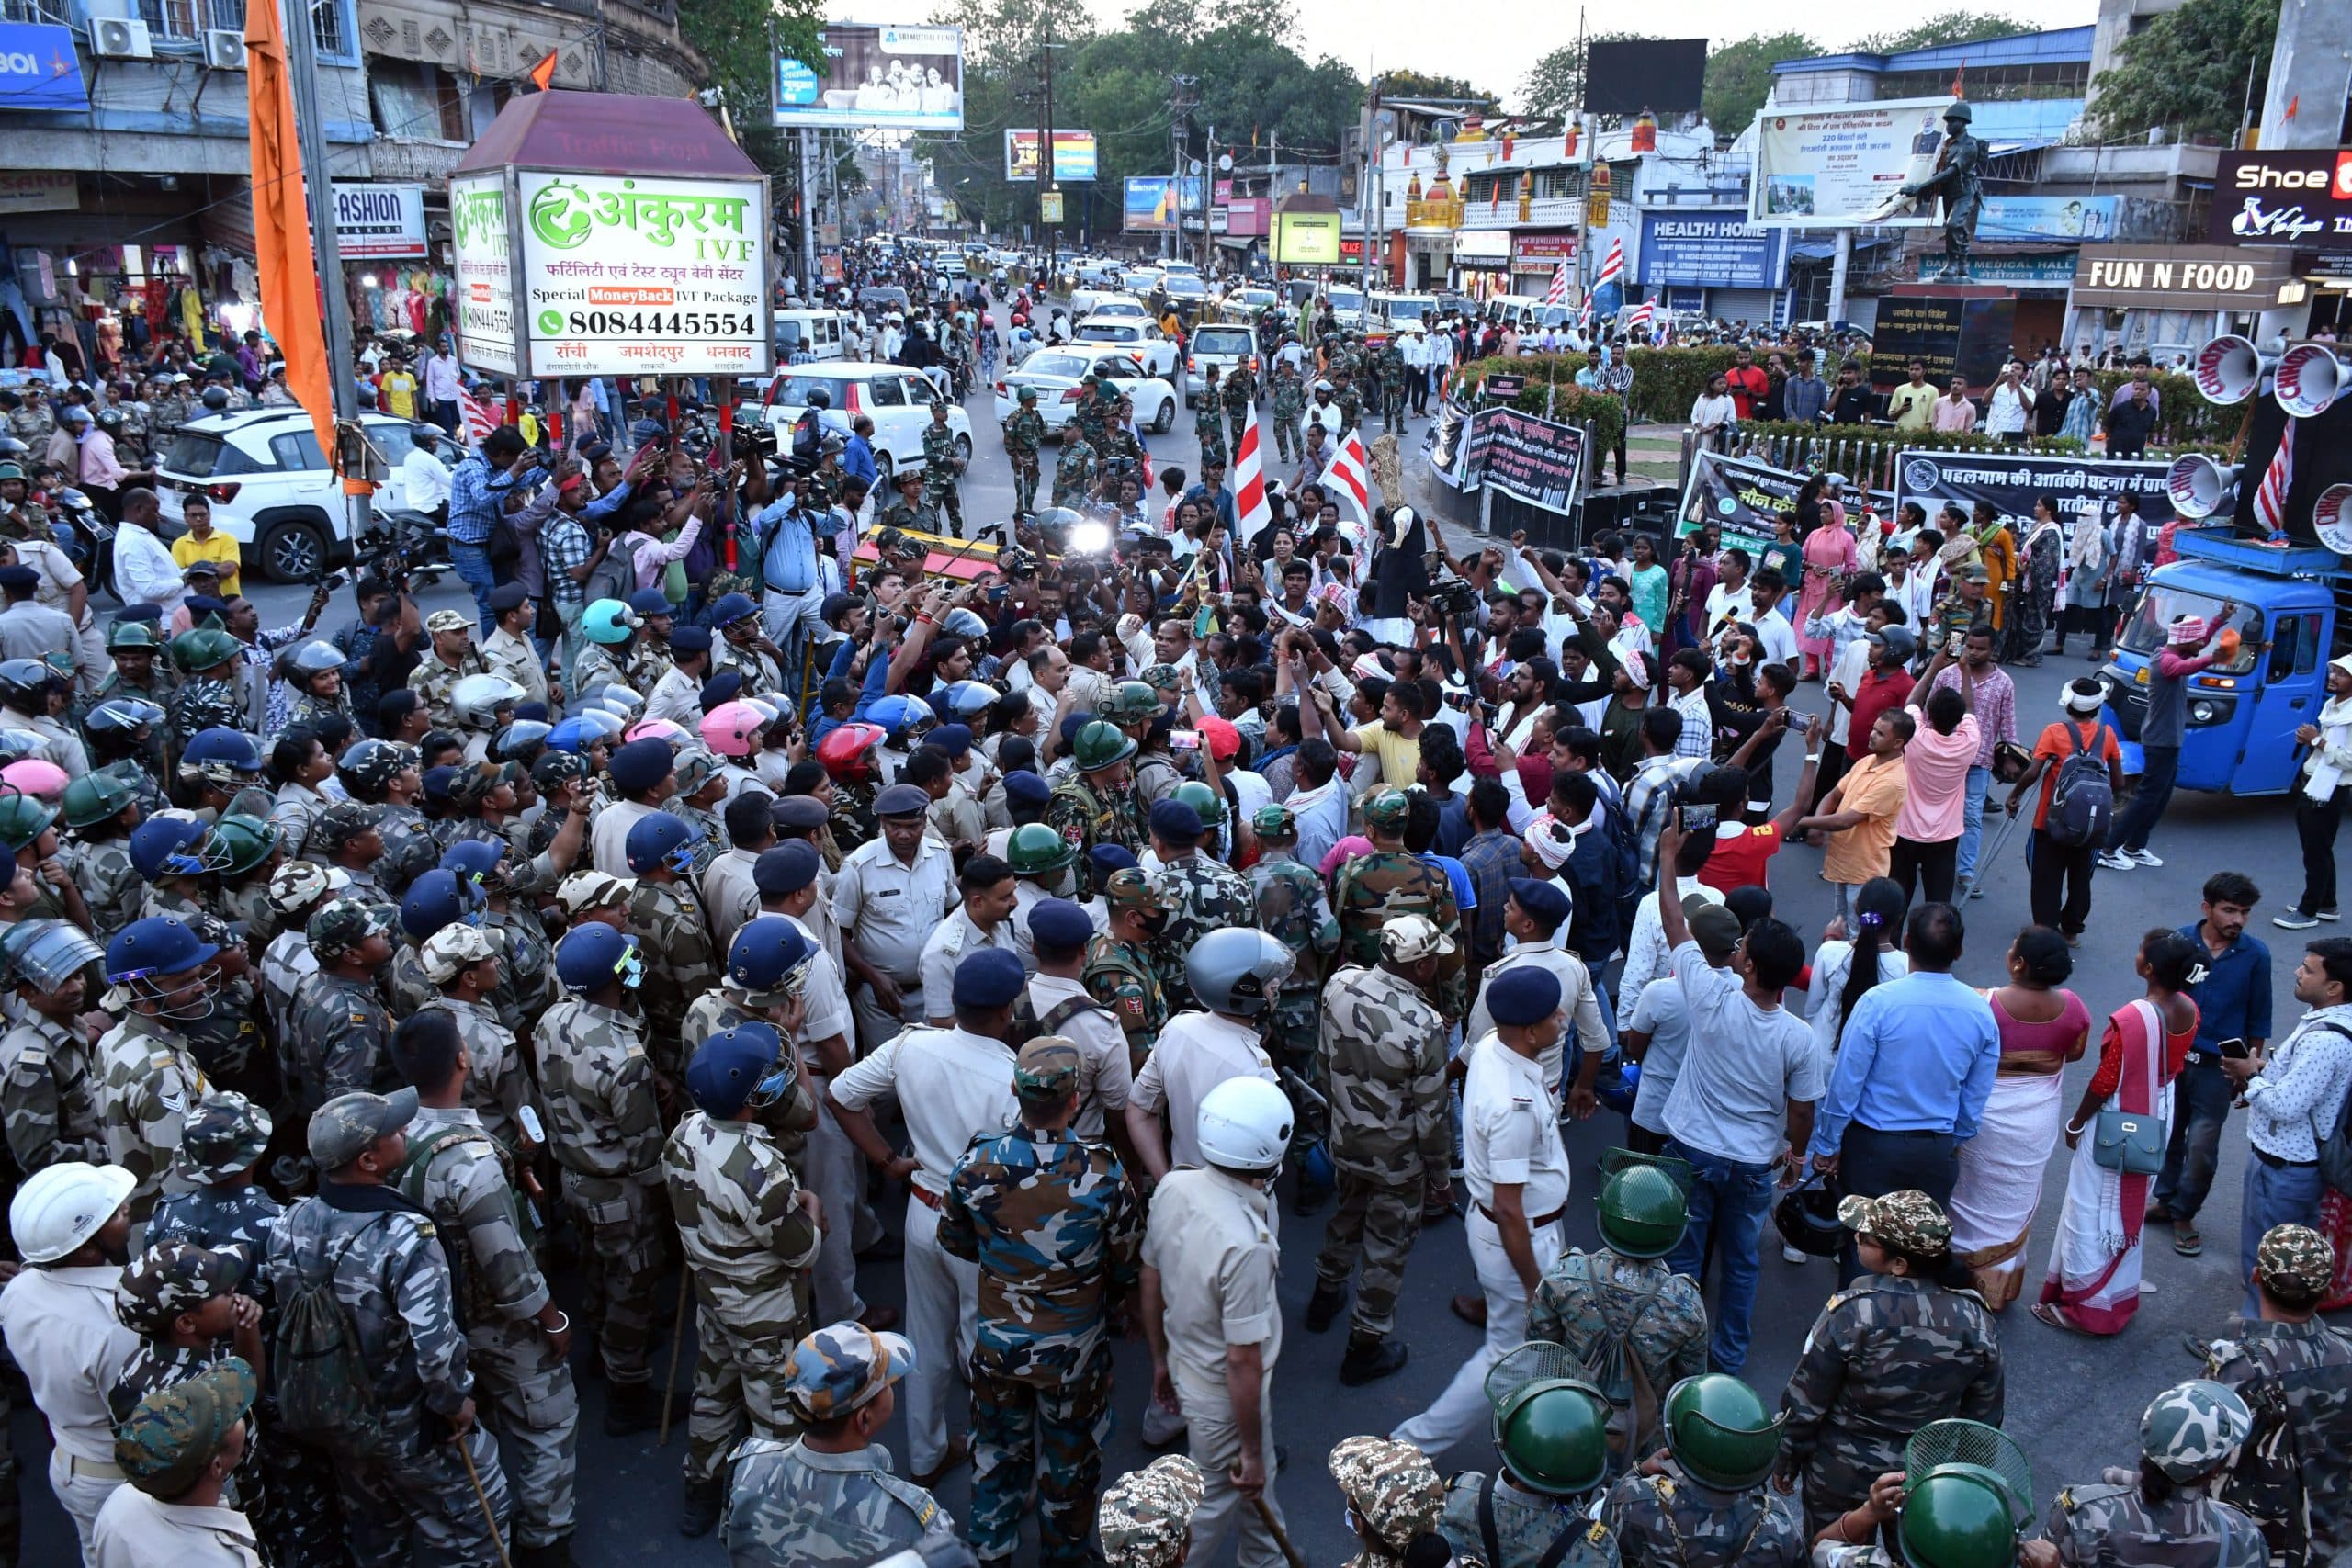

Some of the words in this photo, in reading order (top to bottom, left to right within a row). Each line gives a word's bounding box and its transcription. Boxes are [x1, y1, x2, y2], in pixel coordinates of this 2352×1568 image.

[2235, 165, 2329, 188] Shoe
[333, 187, 402, 222] ASHION
[592, 179, 751, 248] अंकुरम
[1654, 222, 1716, 237] HEALTH
[1719, 222, 1768, 237] HOME
[695, 238, 755, 262] IVF
[631, 262, 657, 278] टेस्ट
[717, 265, 745, 281] सेंटर
[1974, 260, 2033, 270] MEDICAL
[2037, 260, 2074, 270] HALL
[2089, 262, 2144, 288] FUN
[2152, 263, 2173, 288] N
[2181, 264, 2255, 291] FOOD
[532, 288, 586, 303] Special
[589, 289, 673, 304] MoneyBack
[676, 291, 700, 302] IVF
[704, 291, 758, 306] Package
[569, 311, 756, 335] 8084445554
[618, 342, 685, 363] जमशेदपुर
[1941, 468, 2009, 486] पहलगाम
[2009, 468, 2032, 487] की
[2033, 469, 2087, 489] आतंकी
[2087, 475, 2128, 491] घटना
[2128, 473, 2143, 492] में
[1738, 487, 1772, 509] मौन
